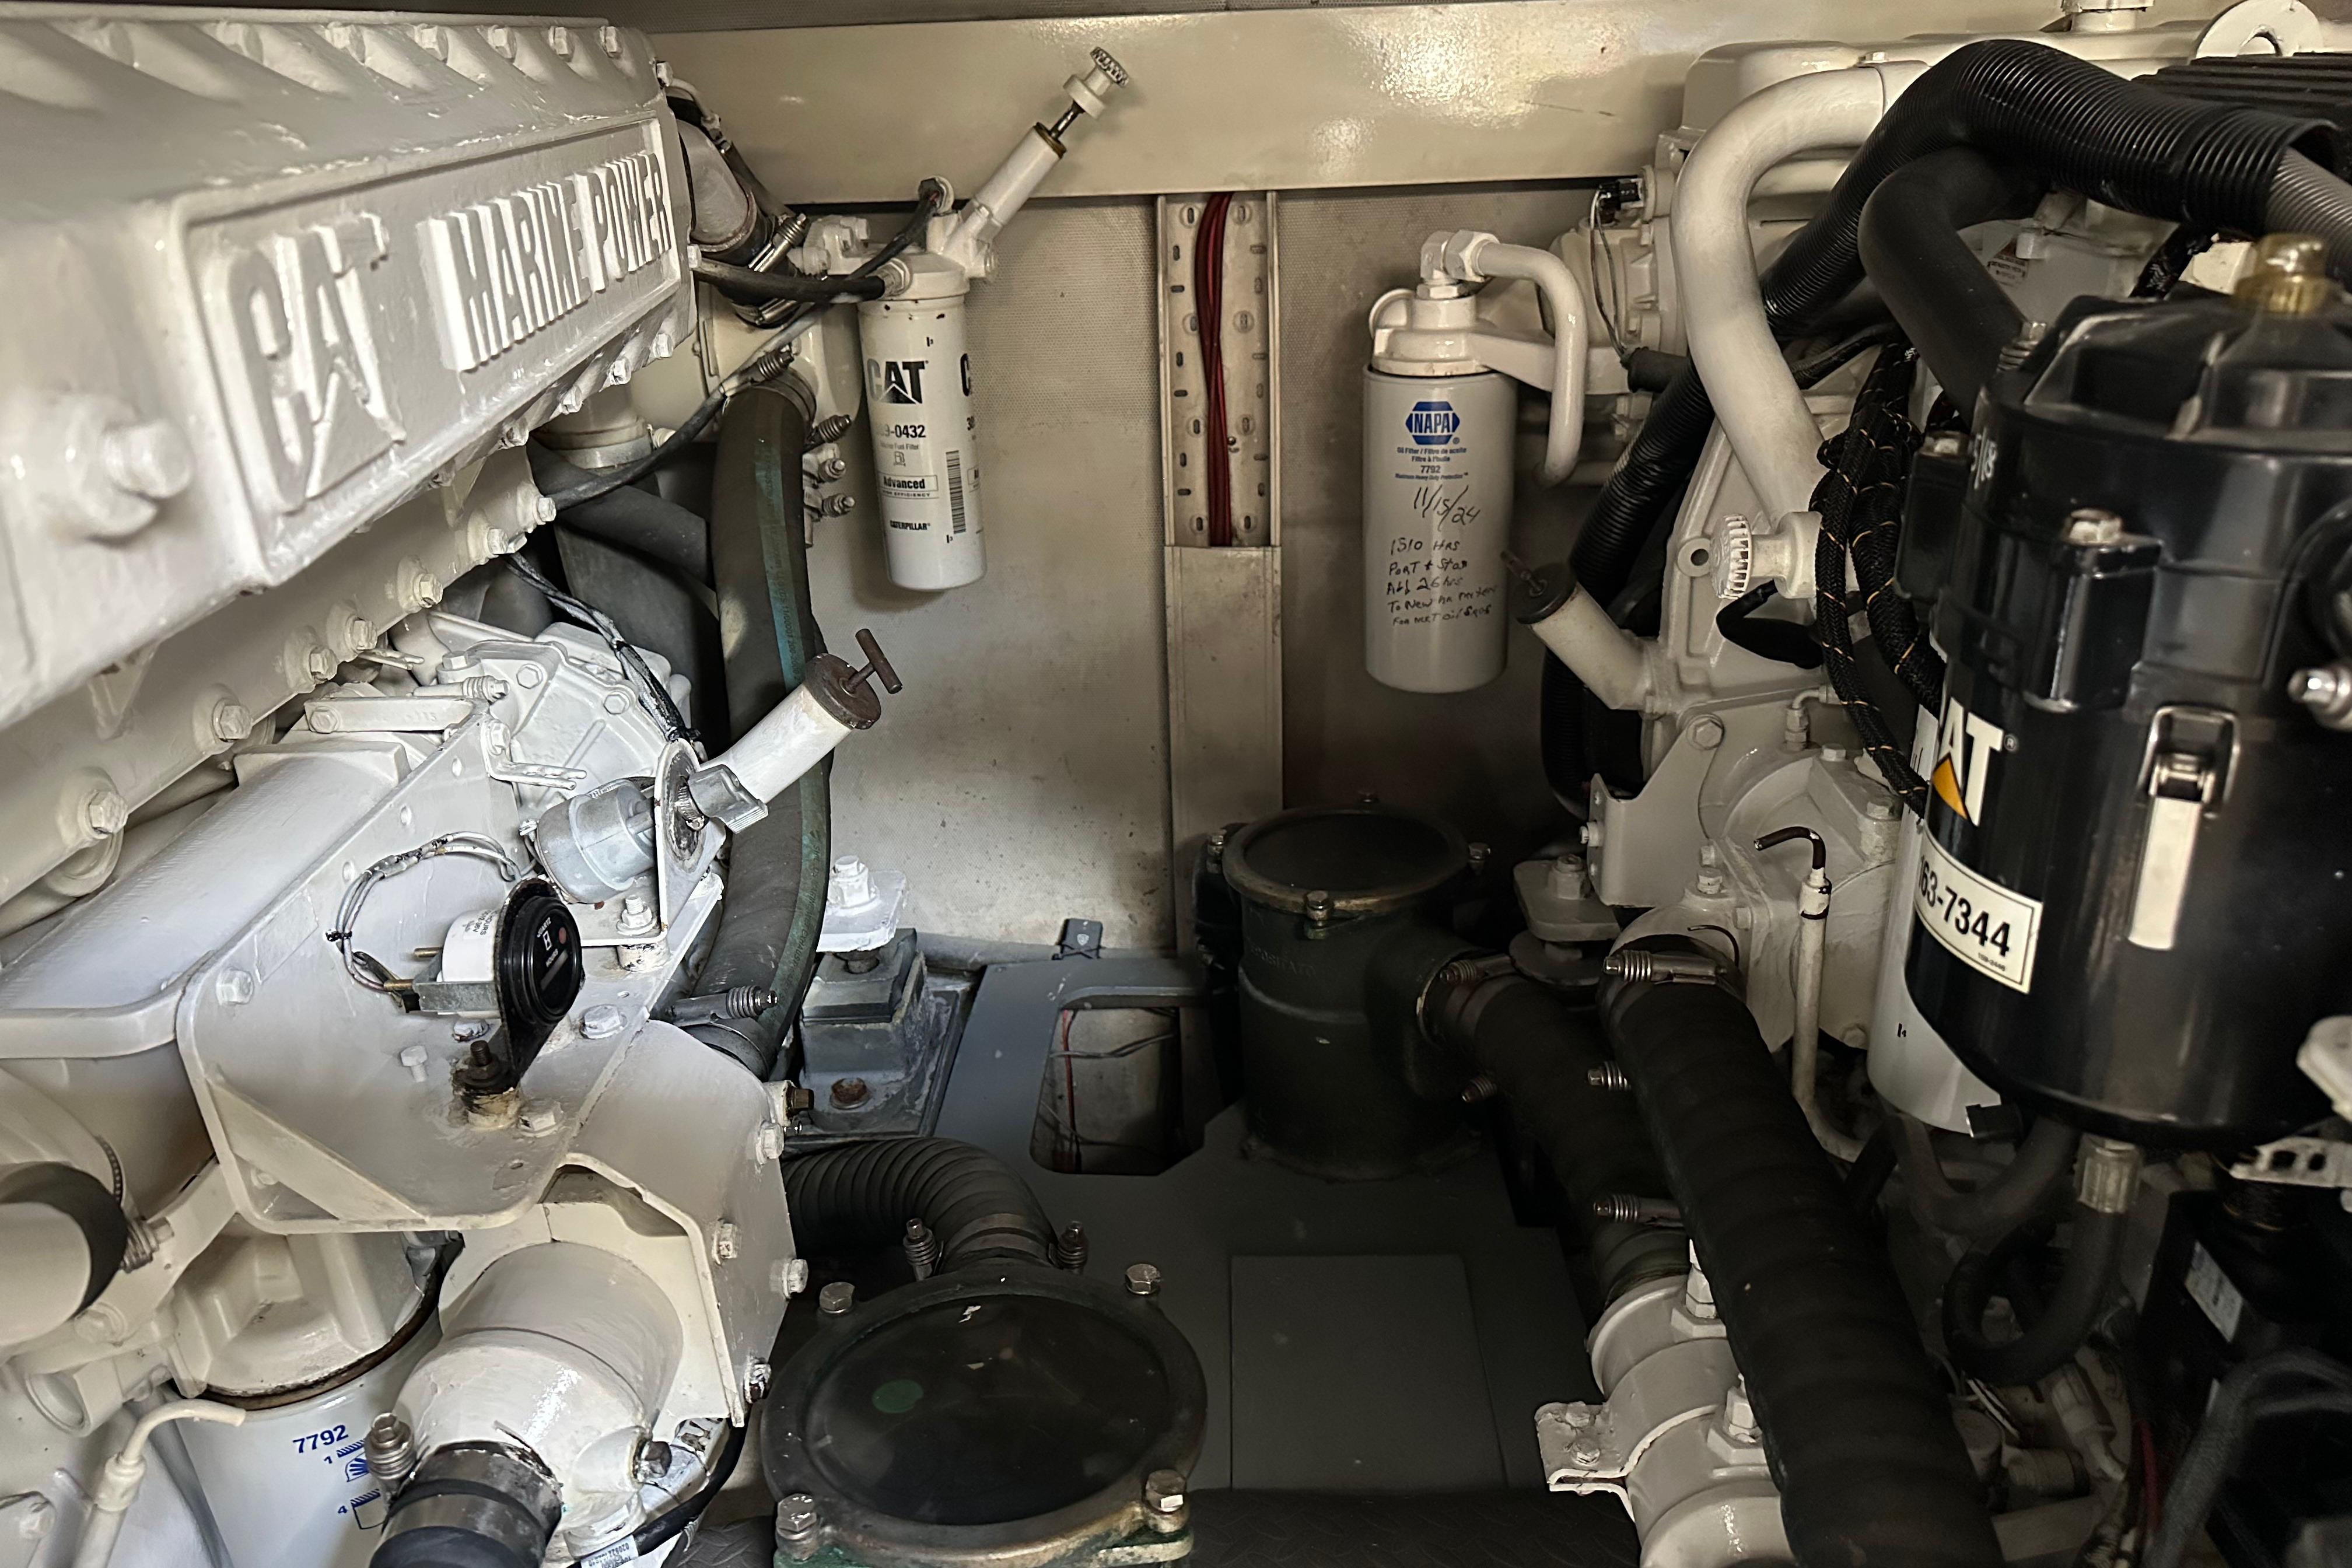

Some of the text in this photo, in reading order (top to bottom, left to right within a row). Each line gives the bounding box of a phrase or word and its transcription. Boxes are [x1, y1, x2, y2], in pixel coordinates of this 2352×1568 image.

[225, 153, 673, 513] CAT MARINE POWER
[867, 359, 925, 404] CAT
[1414, 413, 1451, 433] NAPA
[1420, 465, 1441, 473] 7792
[883, 476, 925, 489] Advanced
[1414, 484, 1480, 531] 11/15/24
[890, 520, 928, 530] CATERPILLAR
[1433, 540, 1460, 551] HRS
[1416, 577, 1440, 591] 26
[1936, 697, 2004, 827] AT
[1919, 855, 2011, 957] 163-7344
[293, 1424, 349, 1453] 7792
[338, 1505, 348, 1514] 4
